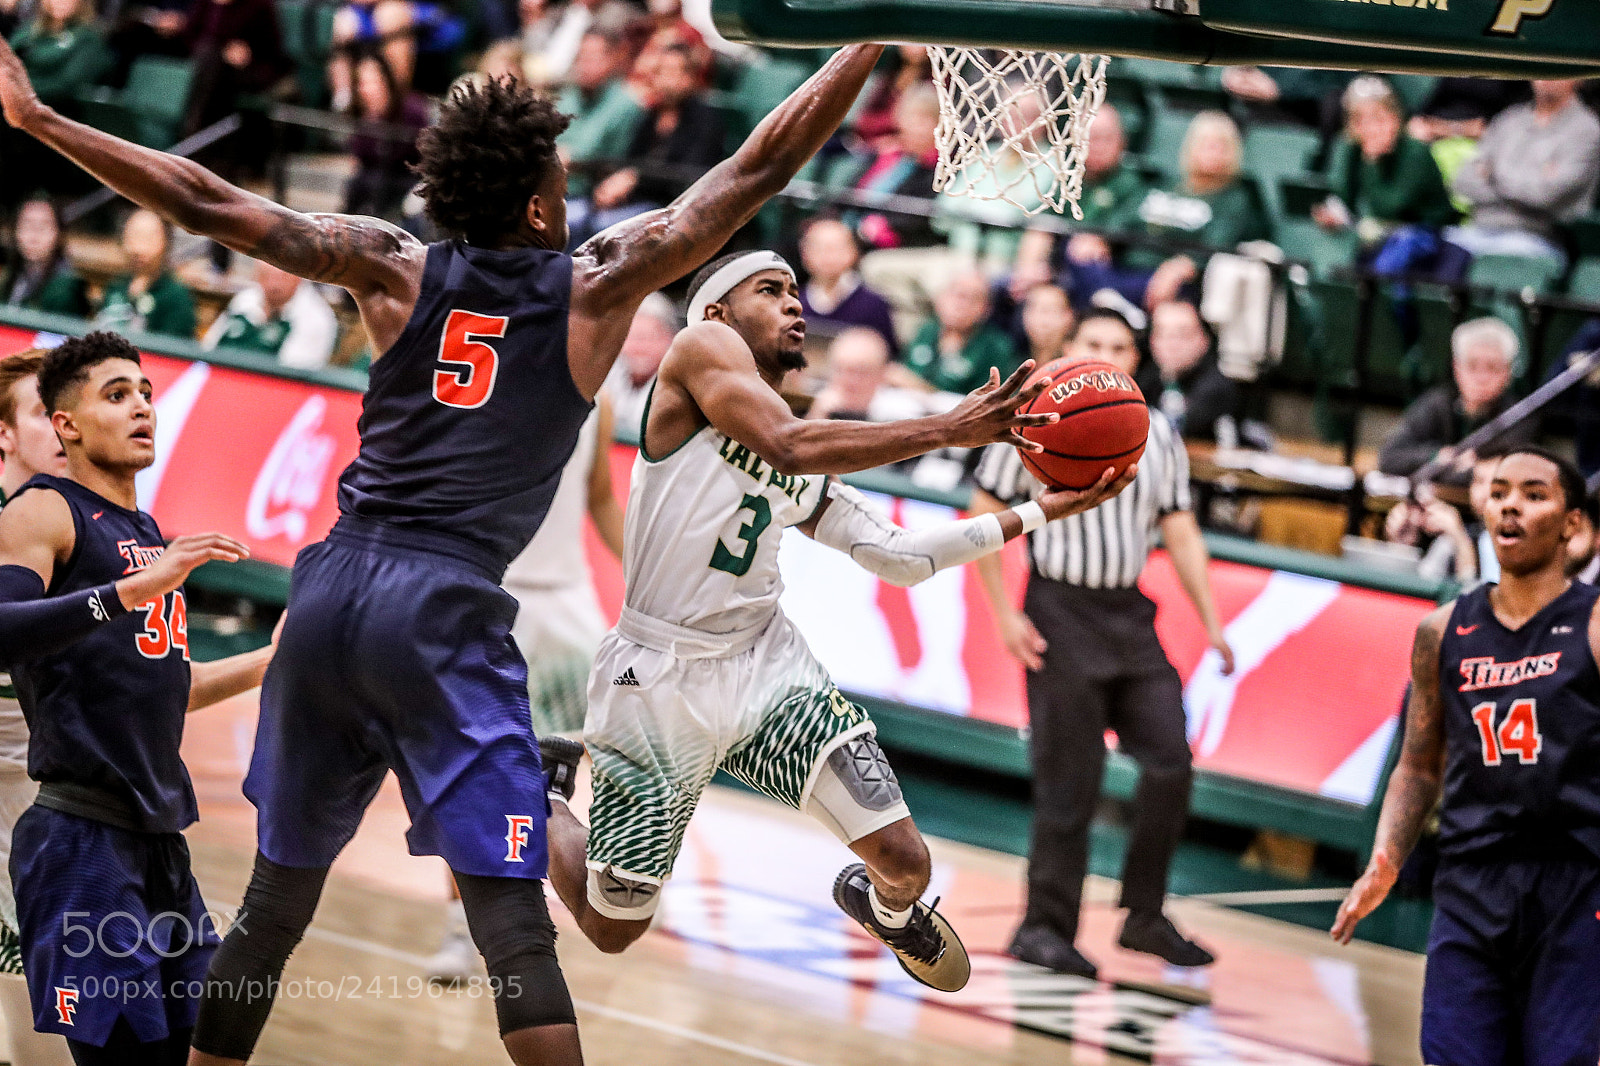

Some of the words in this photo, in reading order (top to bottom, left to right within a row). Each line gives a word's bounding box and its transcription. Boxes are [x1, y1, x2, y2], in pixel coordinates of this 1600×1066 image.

[432, 309, 509, 409] 5
[1048, 370, 1136, 404] Wilson
[708, 493, 772, 577] 3
[134, 590, 191, 661] 34
[1471, 698, 1542, 766] 14
[504, 814, 533, 862] F
[55, 986, 79, 1026] F
